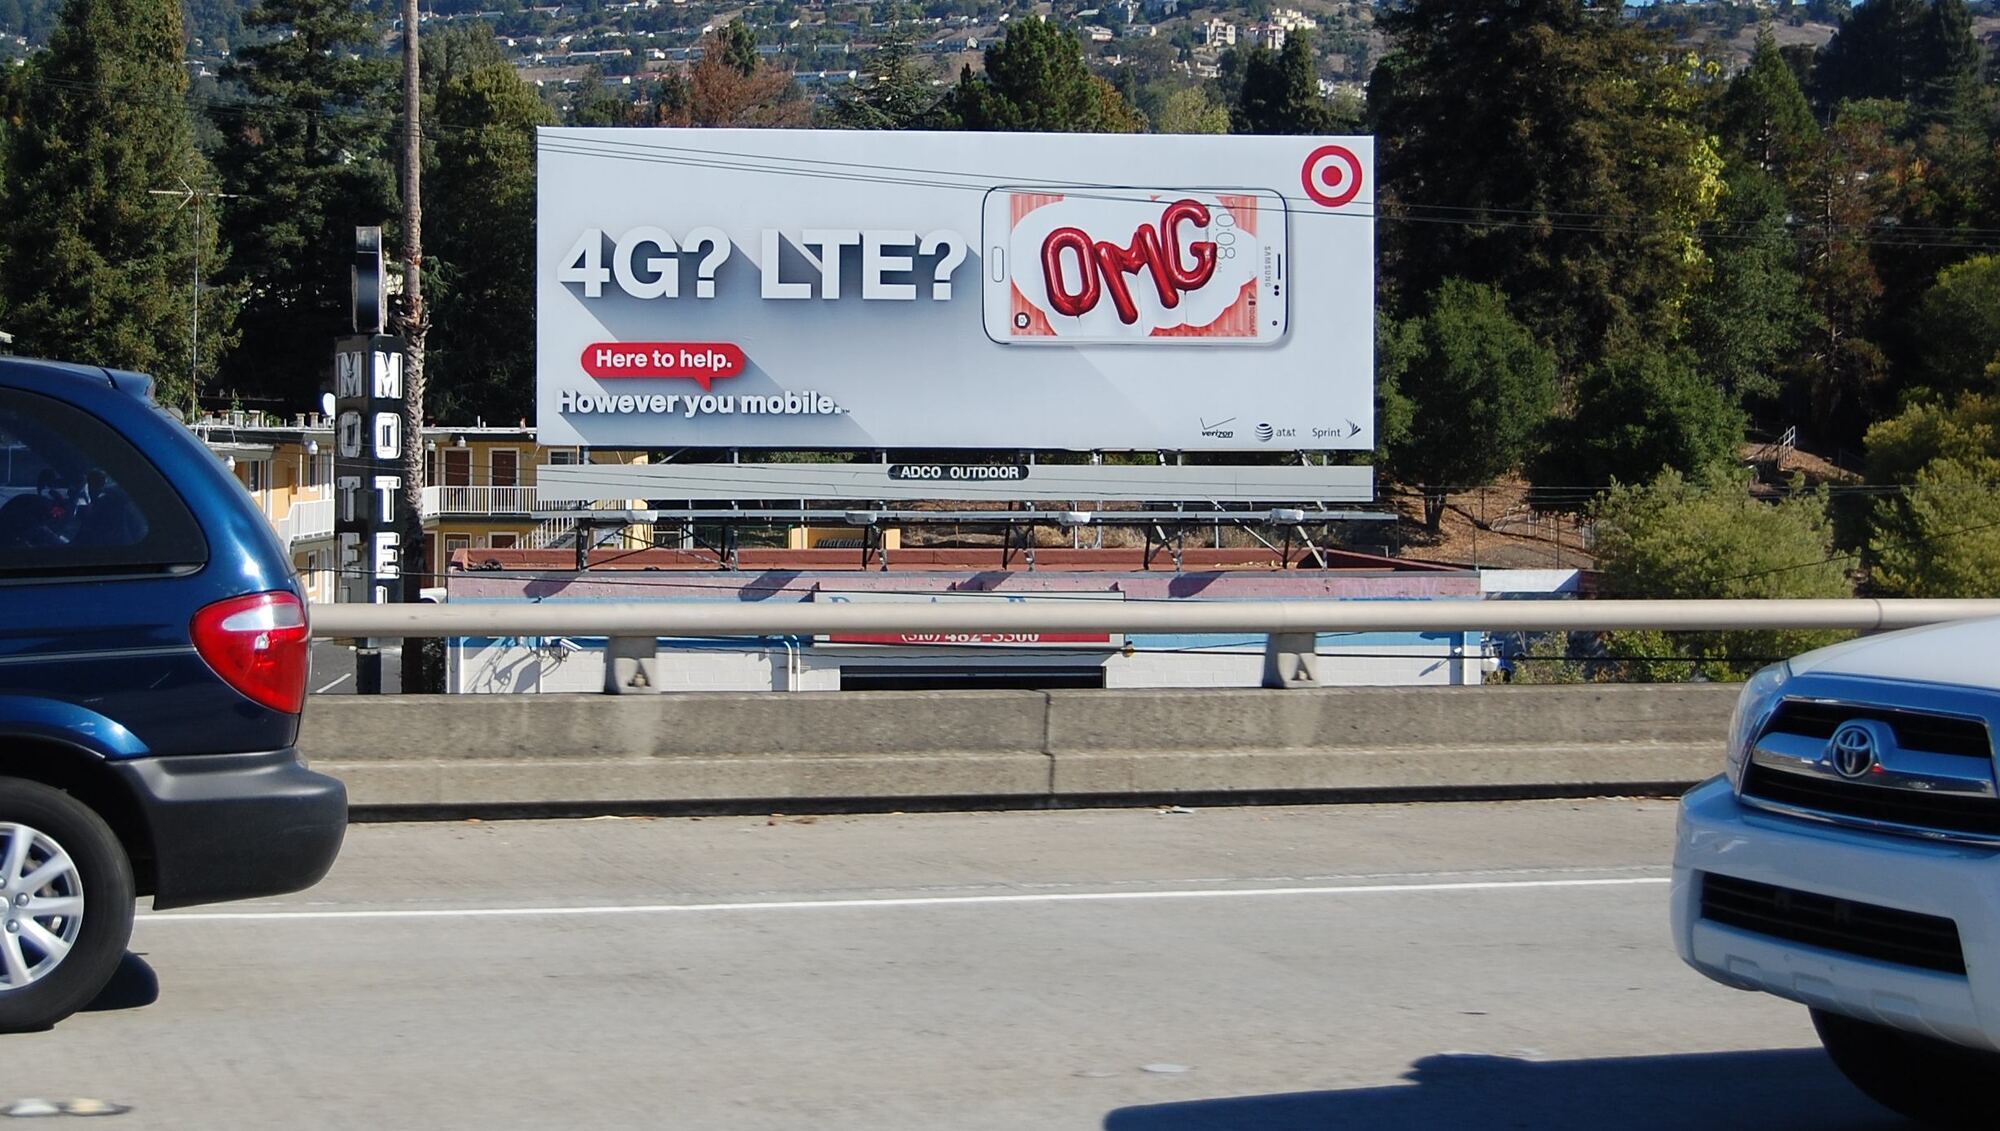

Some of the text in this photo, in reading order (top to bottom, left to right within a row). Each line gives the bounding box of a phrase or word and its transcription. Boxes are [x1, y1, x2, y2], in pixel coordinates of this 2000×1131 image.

[557, 226, 968, 301] 4G? LTE?
[1041, 199, 1217, 325] OMG
[1264, 245, 1272, 288] SAMSUNG
[595, 349, 733, 372] Here to help.
[557, 389, 679, 414] However
[684, 394, 735, 418] you
[1201, 429, 1234, 439] verizon
[1275, 427, 1297, 438] at&t
[1311, 427, 1342, 439] Sprint
[900, 466, 1020, 480] ADCO OUTDOOR
